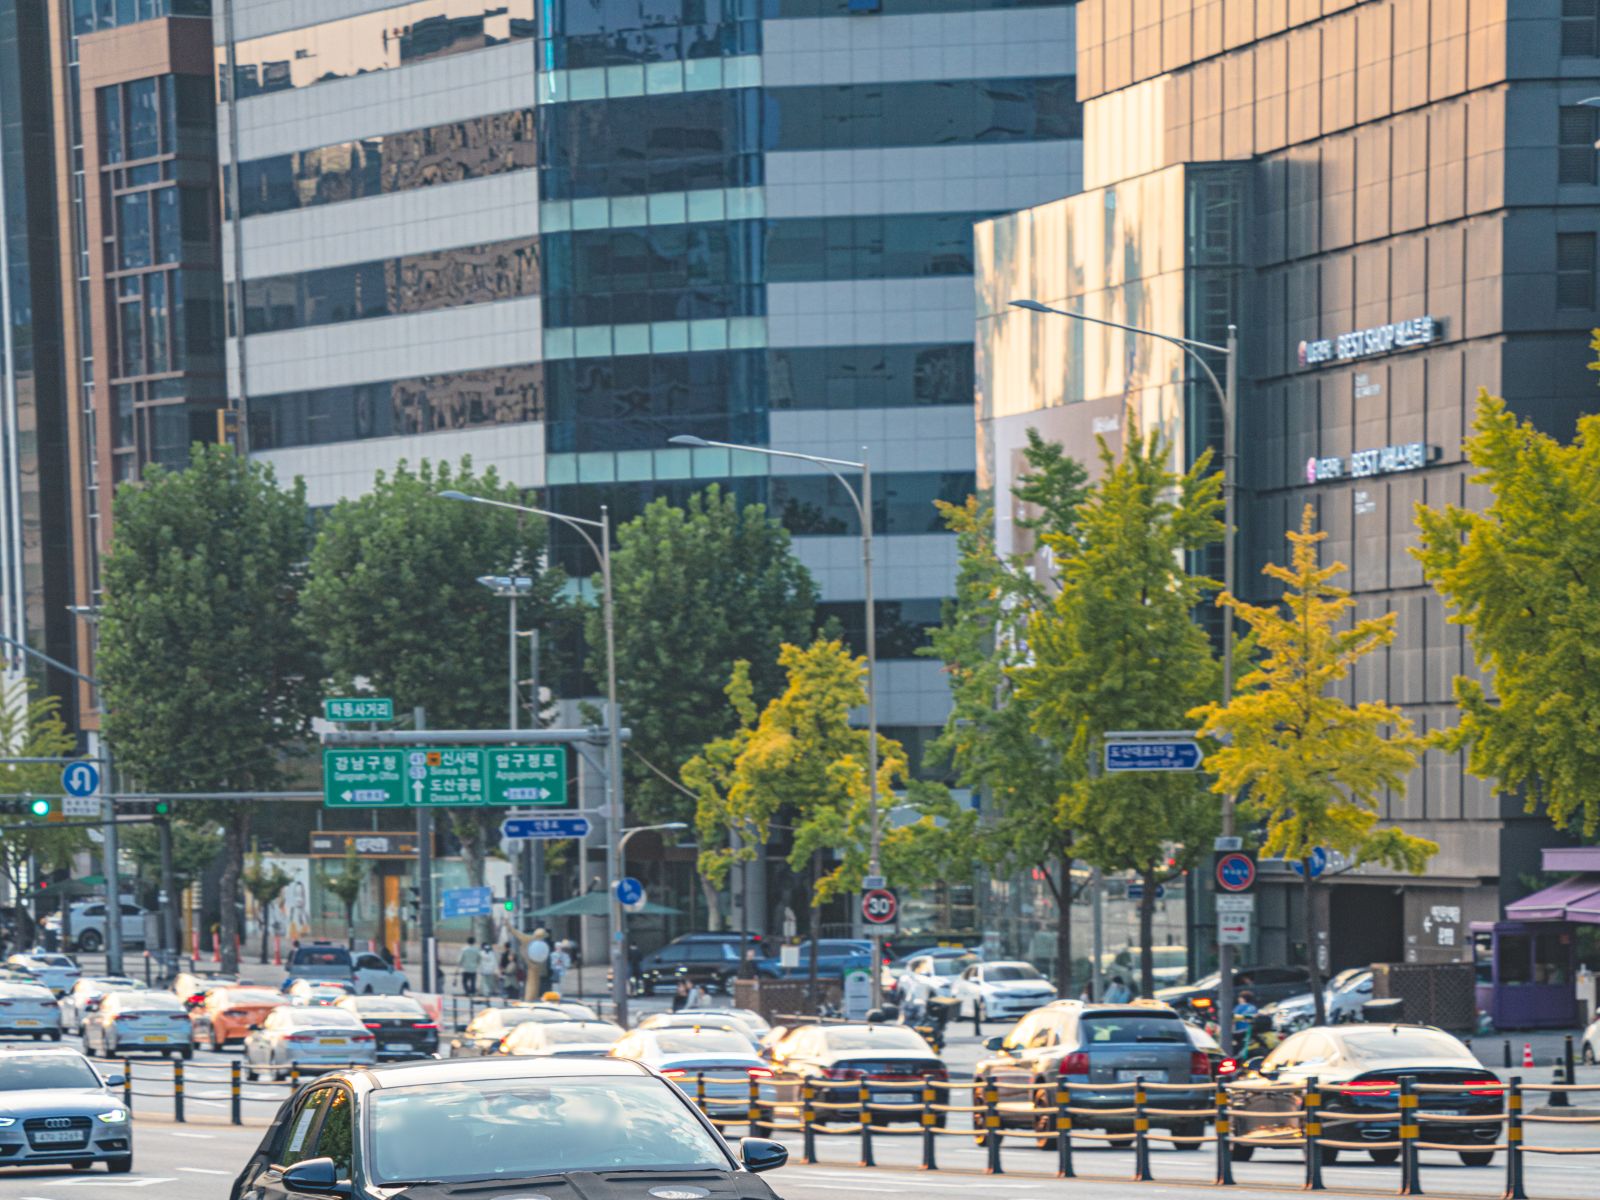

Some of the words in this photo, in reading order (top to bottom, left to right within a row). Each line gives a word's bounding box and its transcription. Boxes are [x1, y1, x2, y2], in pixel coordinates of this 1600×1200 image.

[1337, 331, 1364, 359] BEST
[1365, 324, 1394, 354] SHOP
[1351, 449, 1380, 478] BEST
[331, 702, 388, 717] 학동사거리
[335, 755, 396, 771] 강남구청
[442, 752, 478, 766] 신사역
[496, 753, 556, 768] 압구정로
[430, 778, 481, 792] 도산공원
[870, 897, 889, 914] 30
